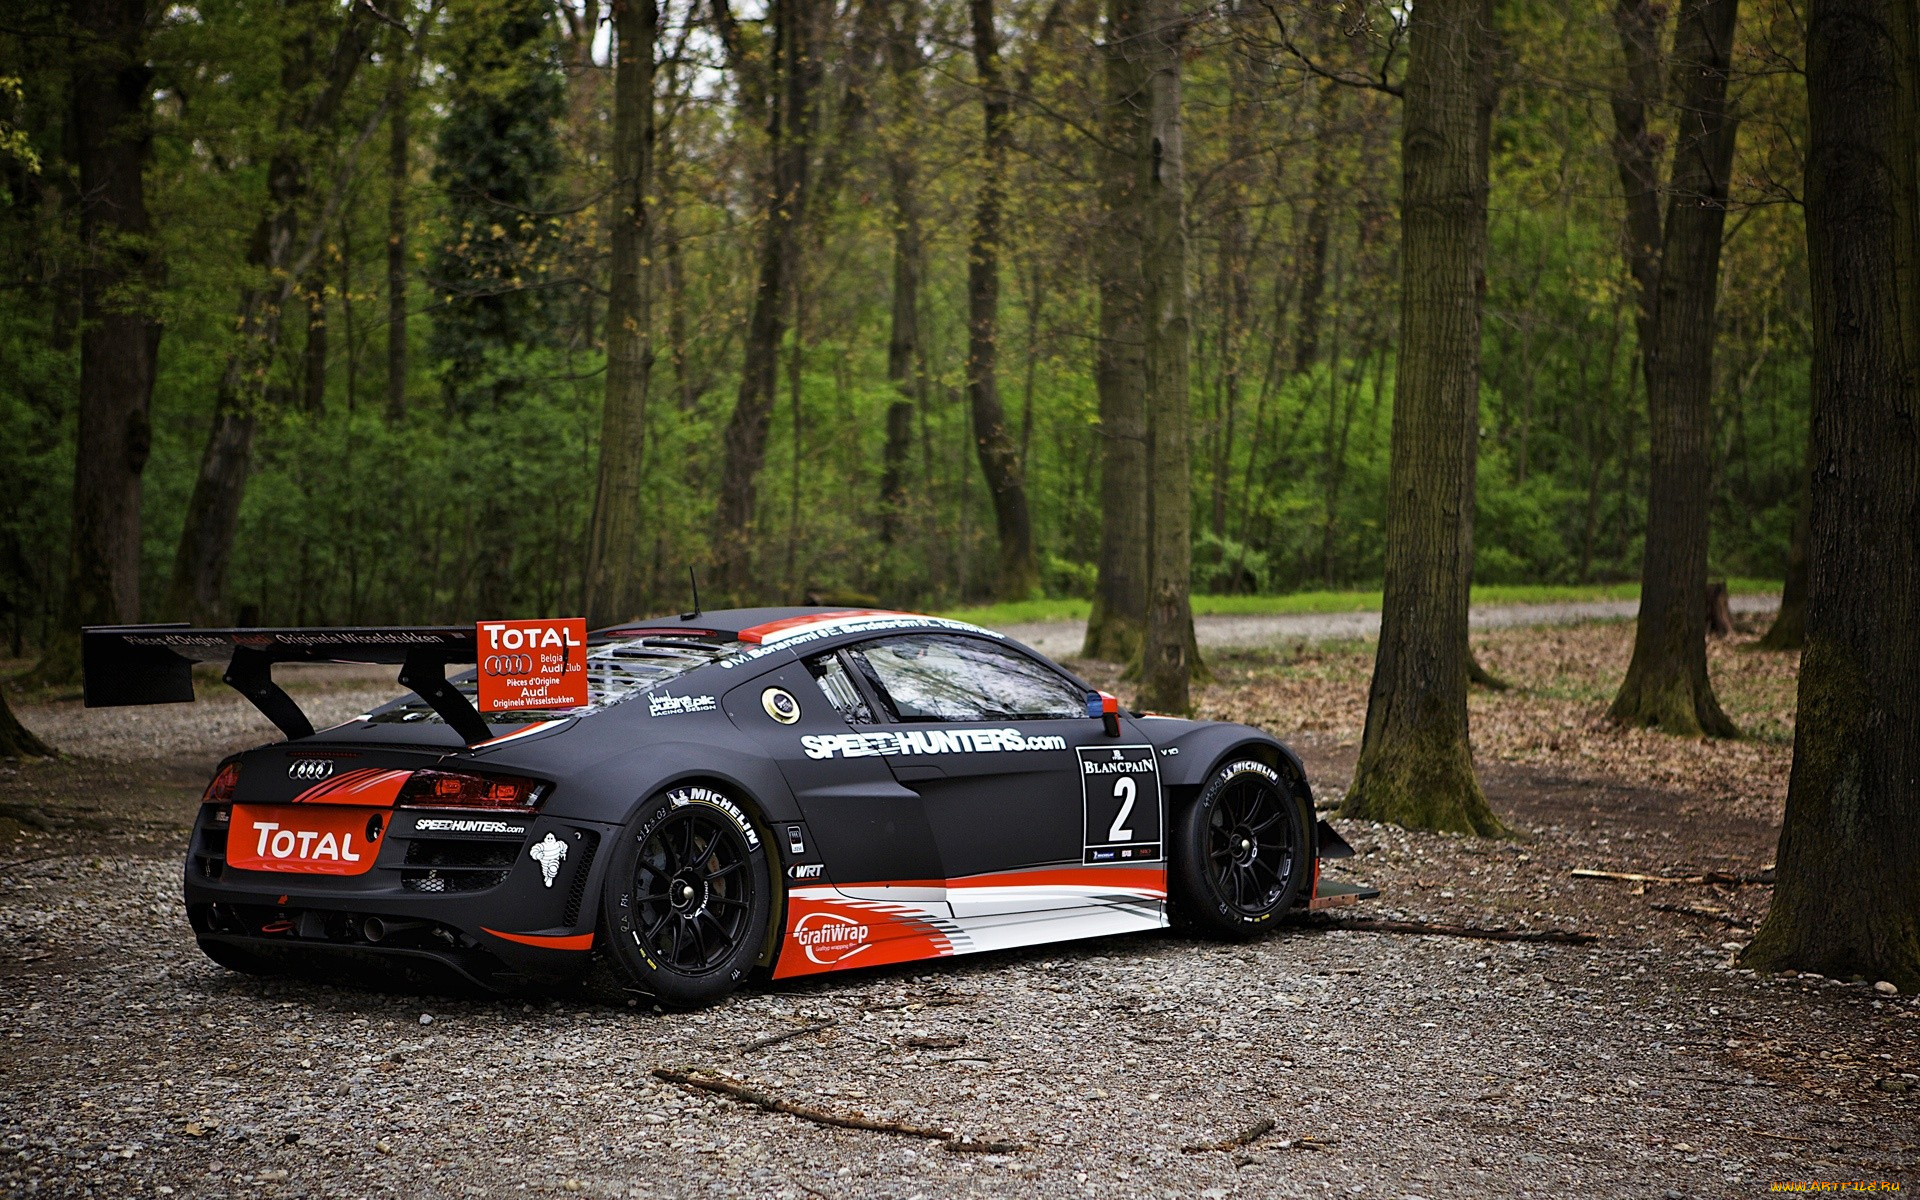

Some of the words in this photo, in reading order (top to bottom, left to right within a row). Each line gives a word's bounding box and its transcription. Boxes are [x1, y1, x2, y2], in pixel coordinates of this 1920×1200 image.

[337, 632, 445, 643] Wisselstukken
[483, 624, 580, 650] TOTAL
[541, 664, 564, 674] Audi
[506, 678, 528, 687] Pièces
[529, 676, 560, 687] d'Origine
[520, 686, 548, 697] Audi
[493, 698, 525, 709] Originele
[526, 695, 575, 706] Wisselstukken
[686, 705, 717, 713] DESIGN
[800, 727, 1068, 760] SPEEDHUNTERS.com
[1083, 758, 1155, 775] BLANCPAIN
[1233, 760, 1278, 781] MICHELIN
[690, 787, 759, 845] MICHELIN
[1108, 776, 1136, 842] 2
[415, 819, 525, 834] SPEEDHUNTERS.com
[253, 821, 360, 862] TOTAL
[795, 863, 824, 878] WRT
[798, 923, 869, 946] GrafiWrap
